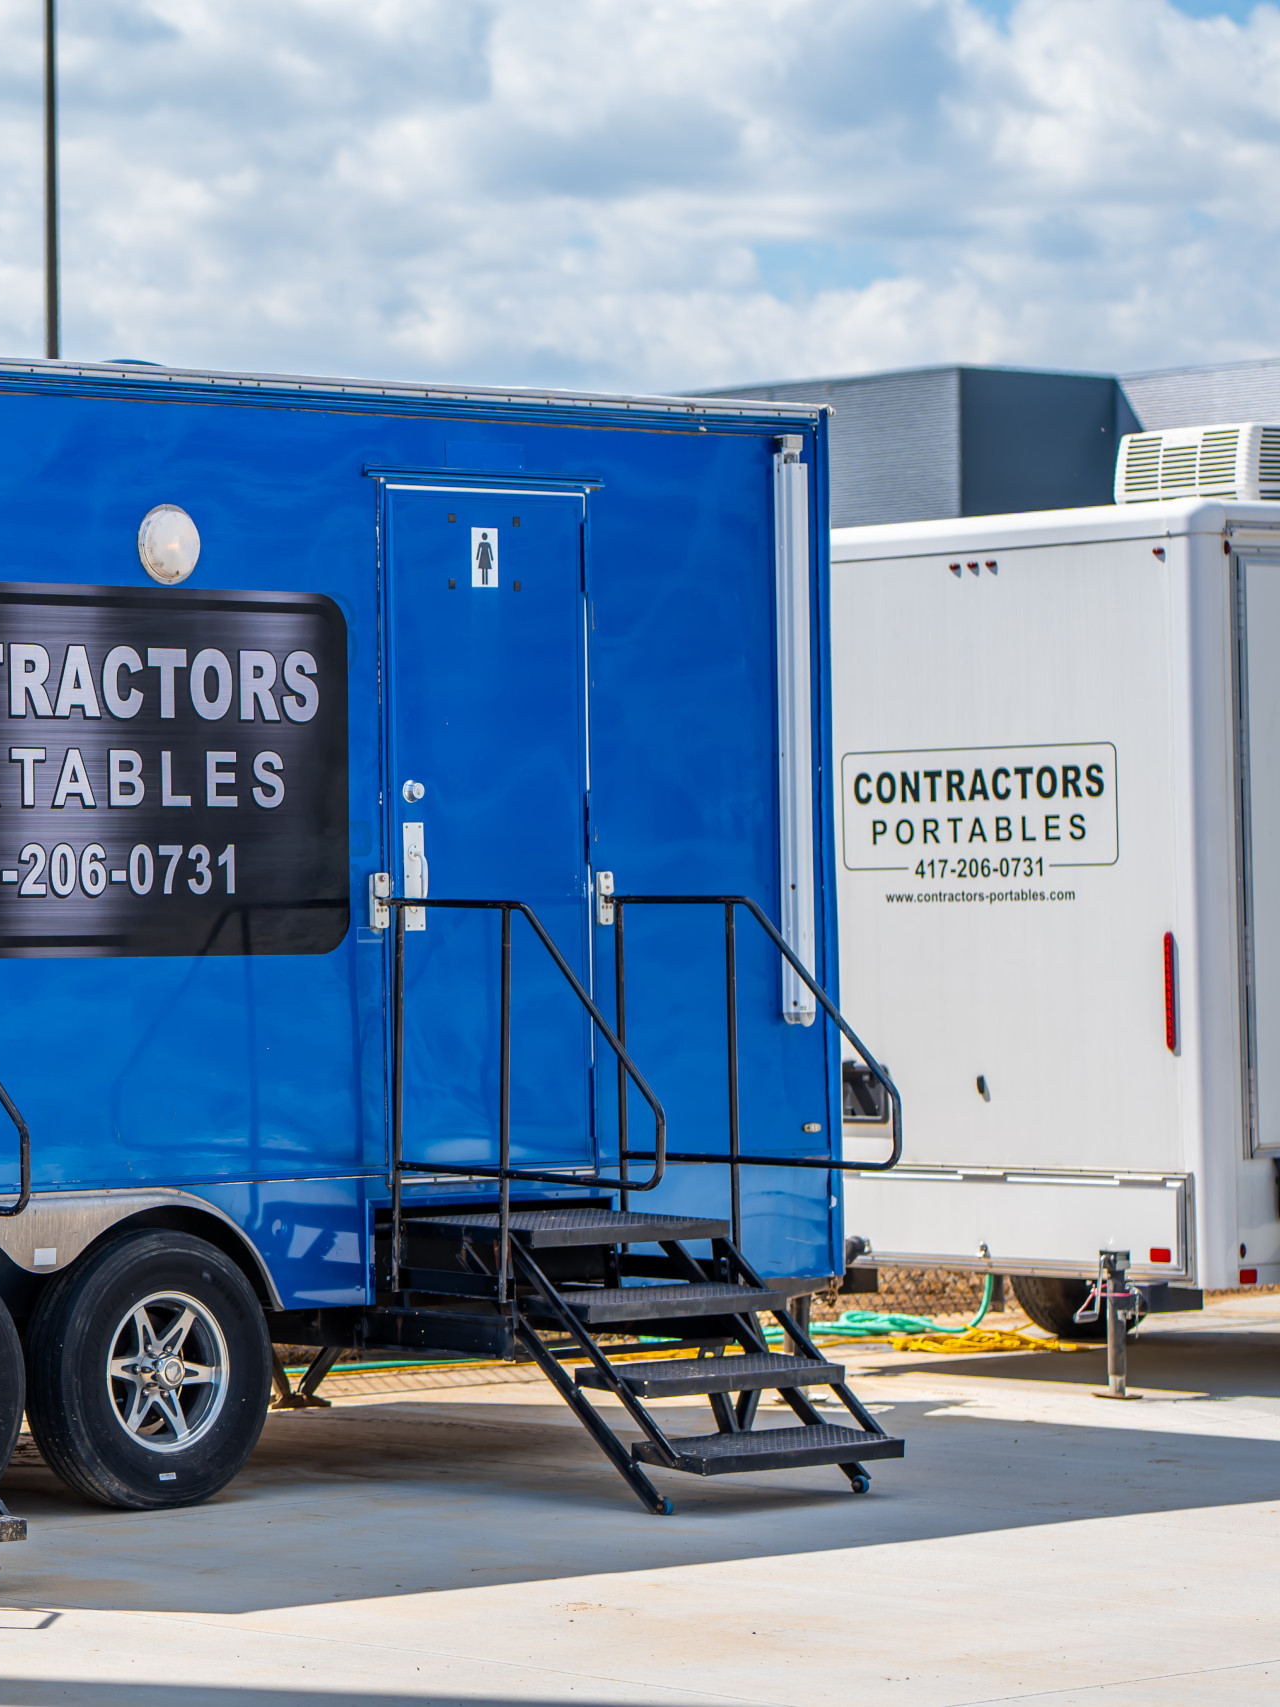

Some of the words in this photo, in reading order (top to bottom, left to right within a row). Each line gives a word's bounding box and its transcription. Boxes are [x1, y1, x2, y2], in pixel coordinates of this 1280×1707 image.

[853, 763, 1105, 805] CONTRACTORS
[872, 813, 1087, 845] PORTABLES
[915, 857, 1044, 878] 417-206-0731
[886, 889, 1076, 905] www.contractors-portables.com
